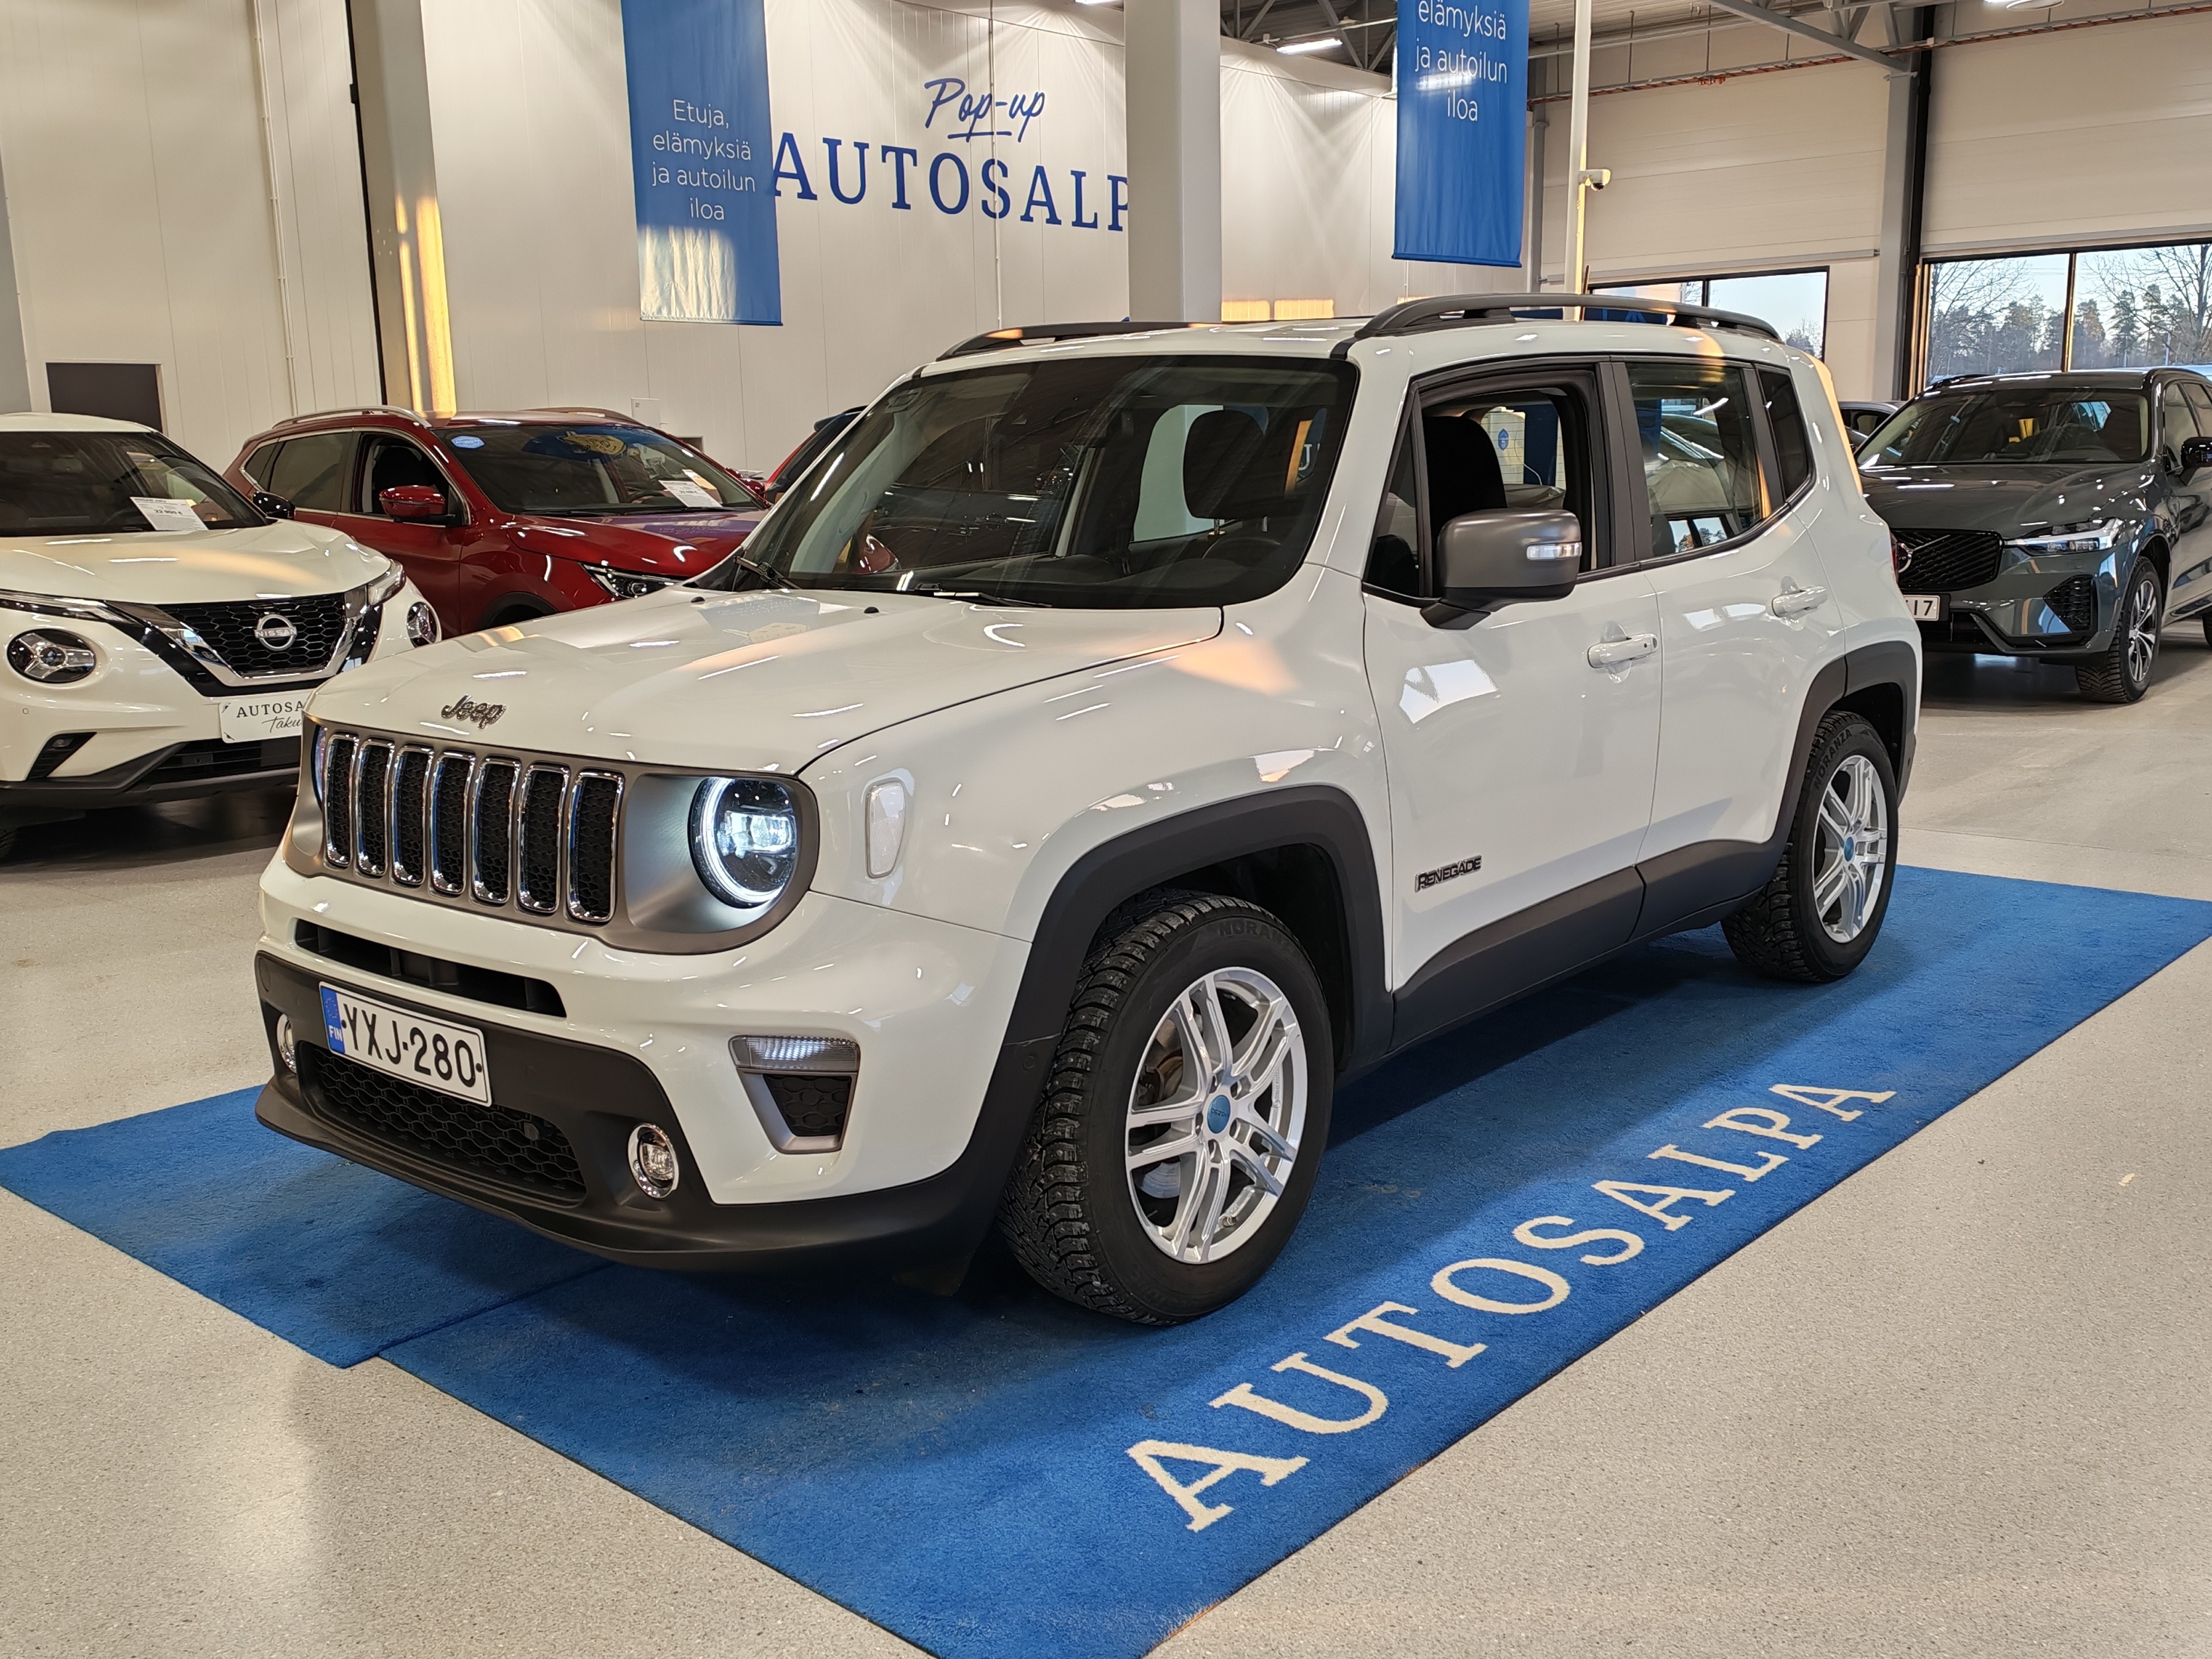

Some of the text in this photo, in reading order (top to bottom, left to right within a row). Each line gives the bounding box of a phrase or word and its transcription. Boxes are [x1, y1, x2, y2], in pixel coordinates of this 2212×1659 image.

[1418, 0, 1506, 41] elämyksiä
[1415, 37, 1507, 84] ja autoilun
[673, 99, 729, 129] Etuja,
[924, 78, 1045, 143] Pop-up
[1447, 89, 1478, 122] iloa
[653, 130, 751, 160] elämyksiä
[652, 161, 756, 192] ja autoilun
[690, 197, 725, 220] iloa
[255, 629, 296, 637] NISSAN
[236, 701, 304, 718] AUTOSA
[441, 694, 507, 729] Jeep
[1414, 855, 1482, 893] RENEGADE
[329, 1024, 343, 1042] FIN
[343, 1003, 476, 1088] YXJ-280
[1125, 1083, 1898, 1533] AUTOSALPA
